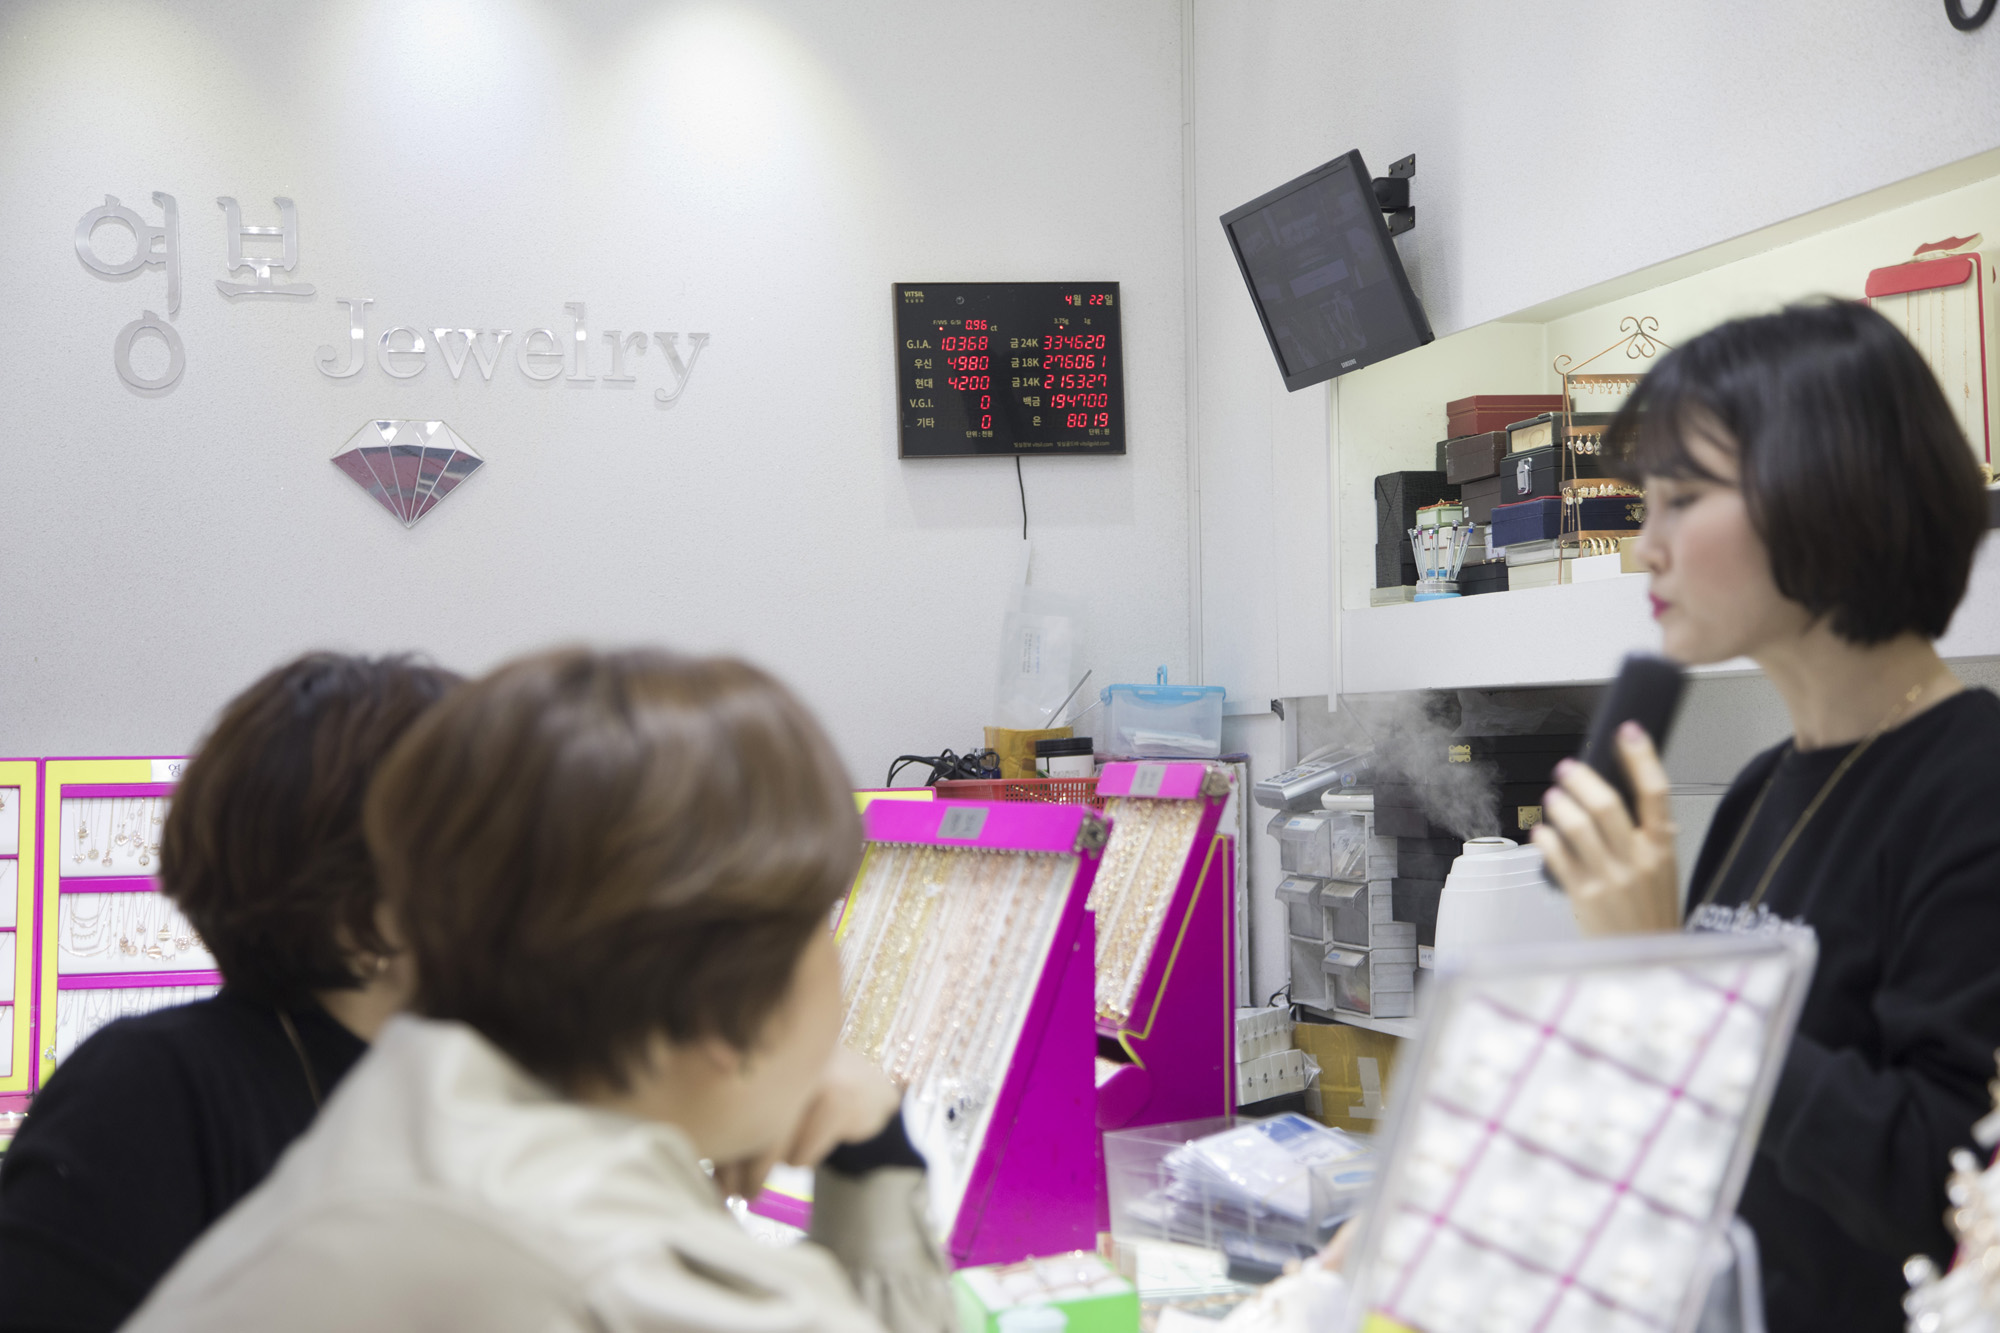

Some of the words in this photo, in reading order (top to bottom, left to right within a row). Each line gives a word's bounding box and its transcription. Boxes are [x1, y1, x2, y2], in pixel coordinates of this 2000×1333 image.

[75, 191, 317, 389] 영보
[906, 340, 932, 349] G.I.A.
[942, 336, 988, 351] 10368
[1010, 338, 1019, 348] 금
[1020, 338, 1038, 348] 24K
[1043, 334, 1106, 350] 334620
[314, 297, 710, 403] Jewelry
[914, 358, 932, 369] 우신
[948, 356, 989, 370] 4980
[1010, 358, 1020, 368] 금
[1022, 358, 1039, 367] 18K
[1043, 354, 1106, 369] 276061
[1340, 358, 1357, 369] SAMSUNG
[915, 378, 933, 389] 현대
[948, 376, 990, 390] 4200
[1011, 377, 1020, 388] 금
[1023, 378, 1040, 387] 14K
[1044, 374, 1107, 389] 215327
[910, 399, 934, 408] V.G.I.
[980, 395, 990, 410] 0
[1022, 396, 1041, 407] 백금
[1051, 393, 1108, 408] 194700
[917, 418, 934, 428] 기타
[981, 414, 992, 429] 0
[1032, 416, 1041, 426] 은
[1067, 412, 1108, 428] 8019
